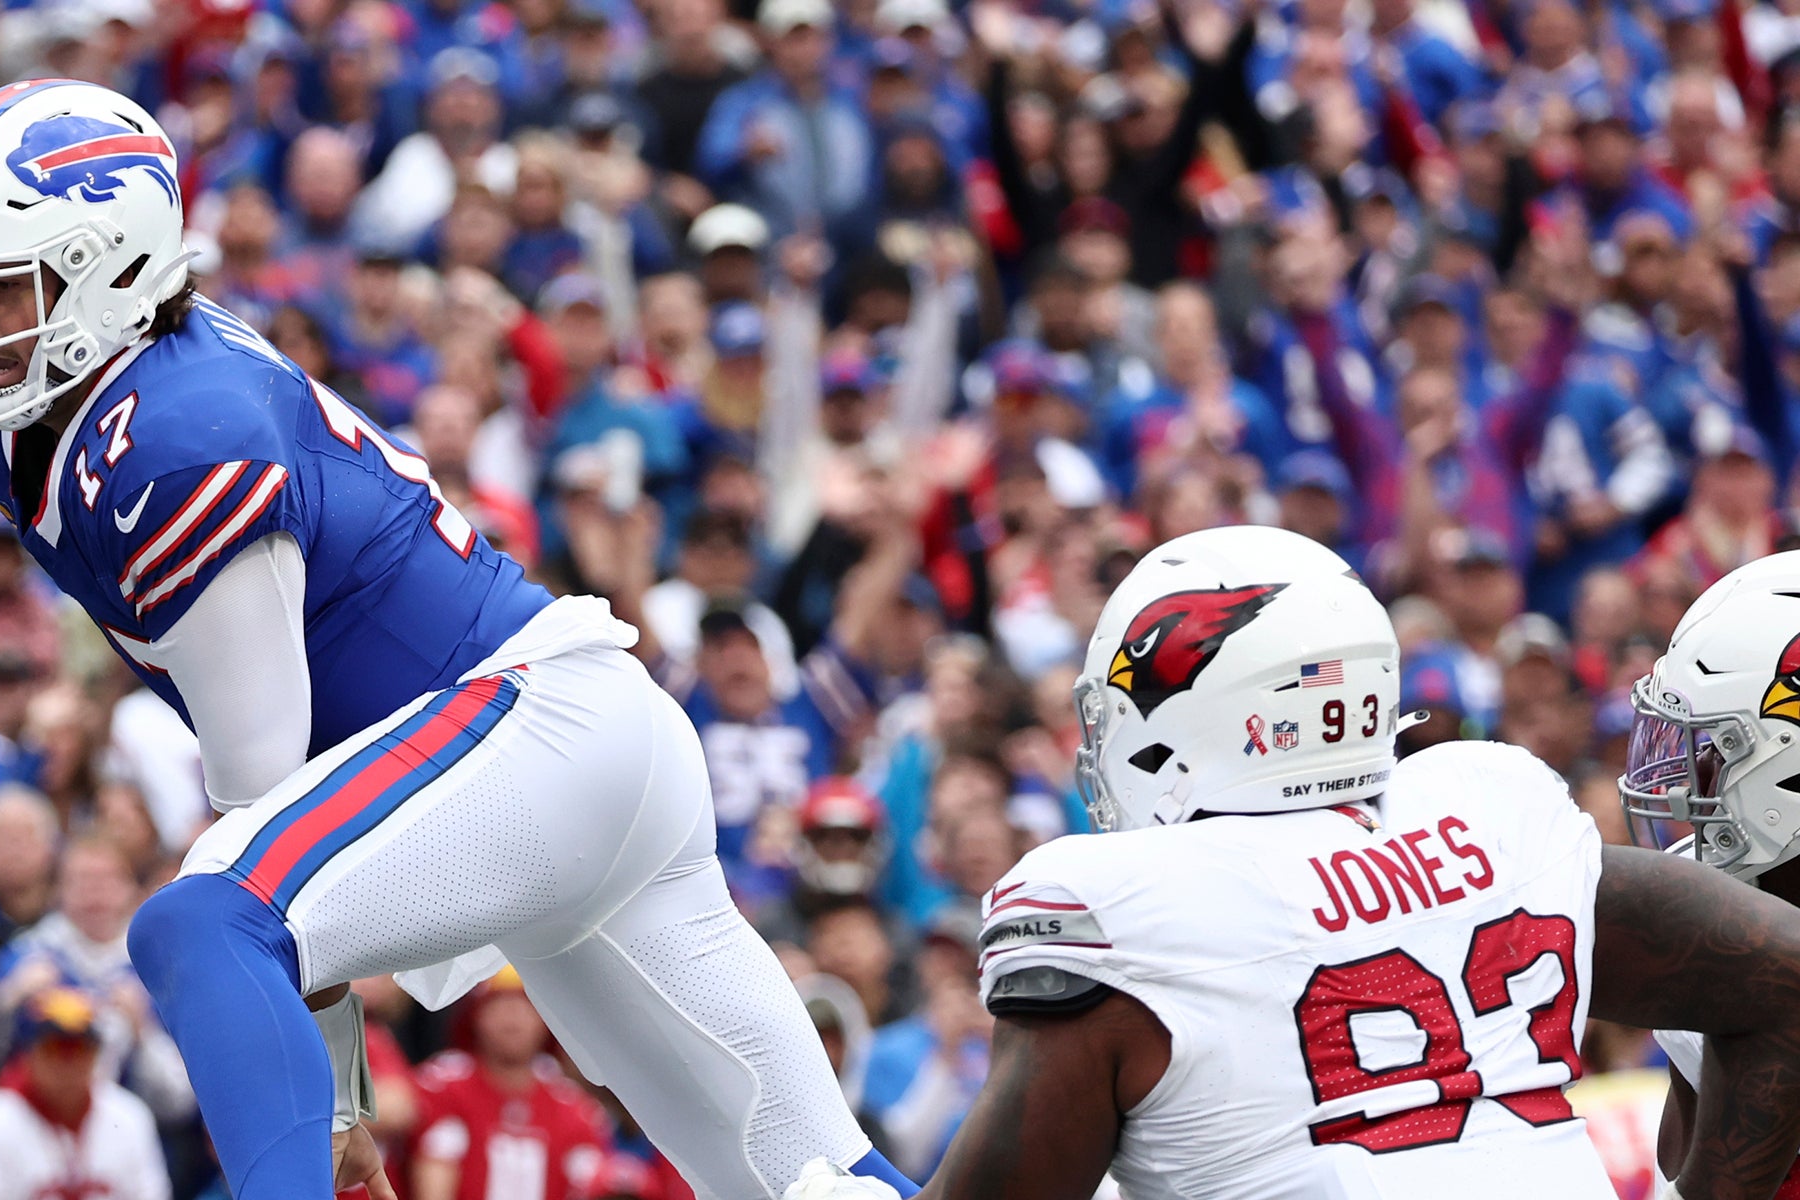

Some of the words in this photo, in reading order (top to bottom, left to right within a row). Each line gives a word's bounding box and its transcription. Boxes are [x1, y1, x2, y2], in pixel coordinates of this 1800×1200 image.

[74, 390, 139, 511] 17
[1275, 733, 1297, 747] NFL
[1658, 701, 1687, 713] OAKLEY
[1282, 784, 1312, 797] SAY
[1317, 777, 1355, 793] THEIR
[1308, 815, 1494, 933] JONES
[1293, 907, 1584, 1156] 93
